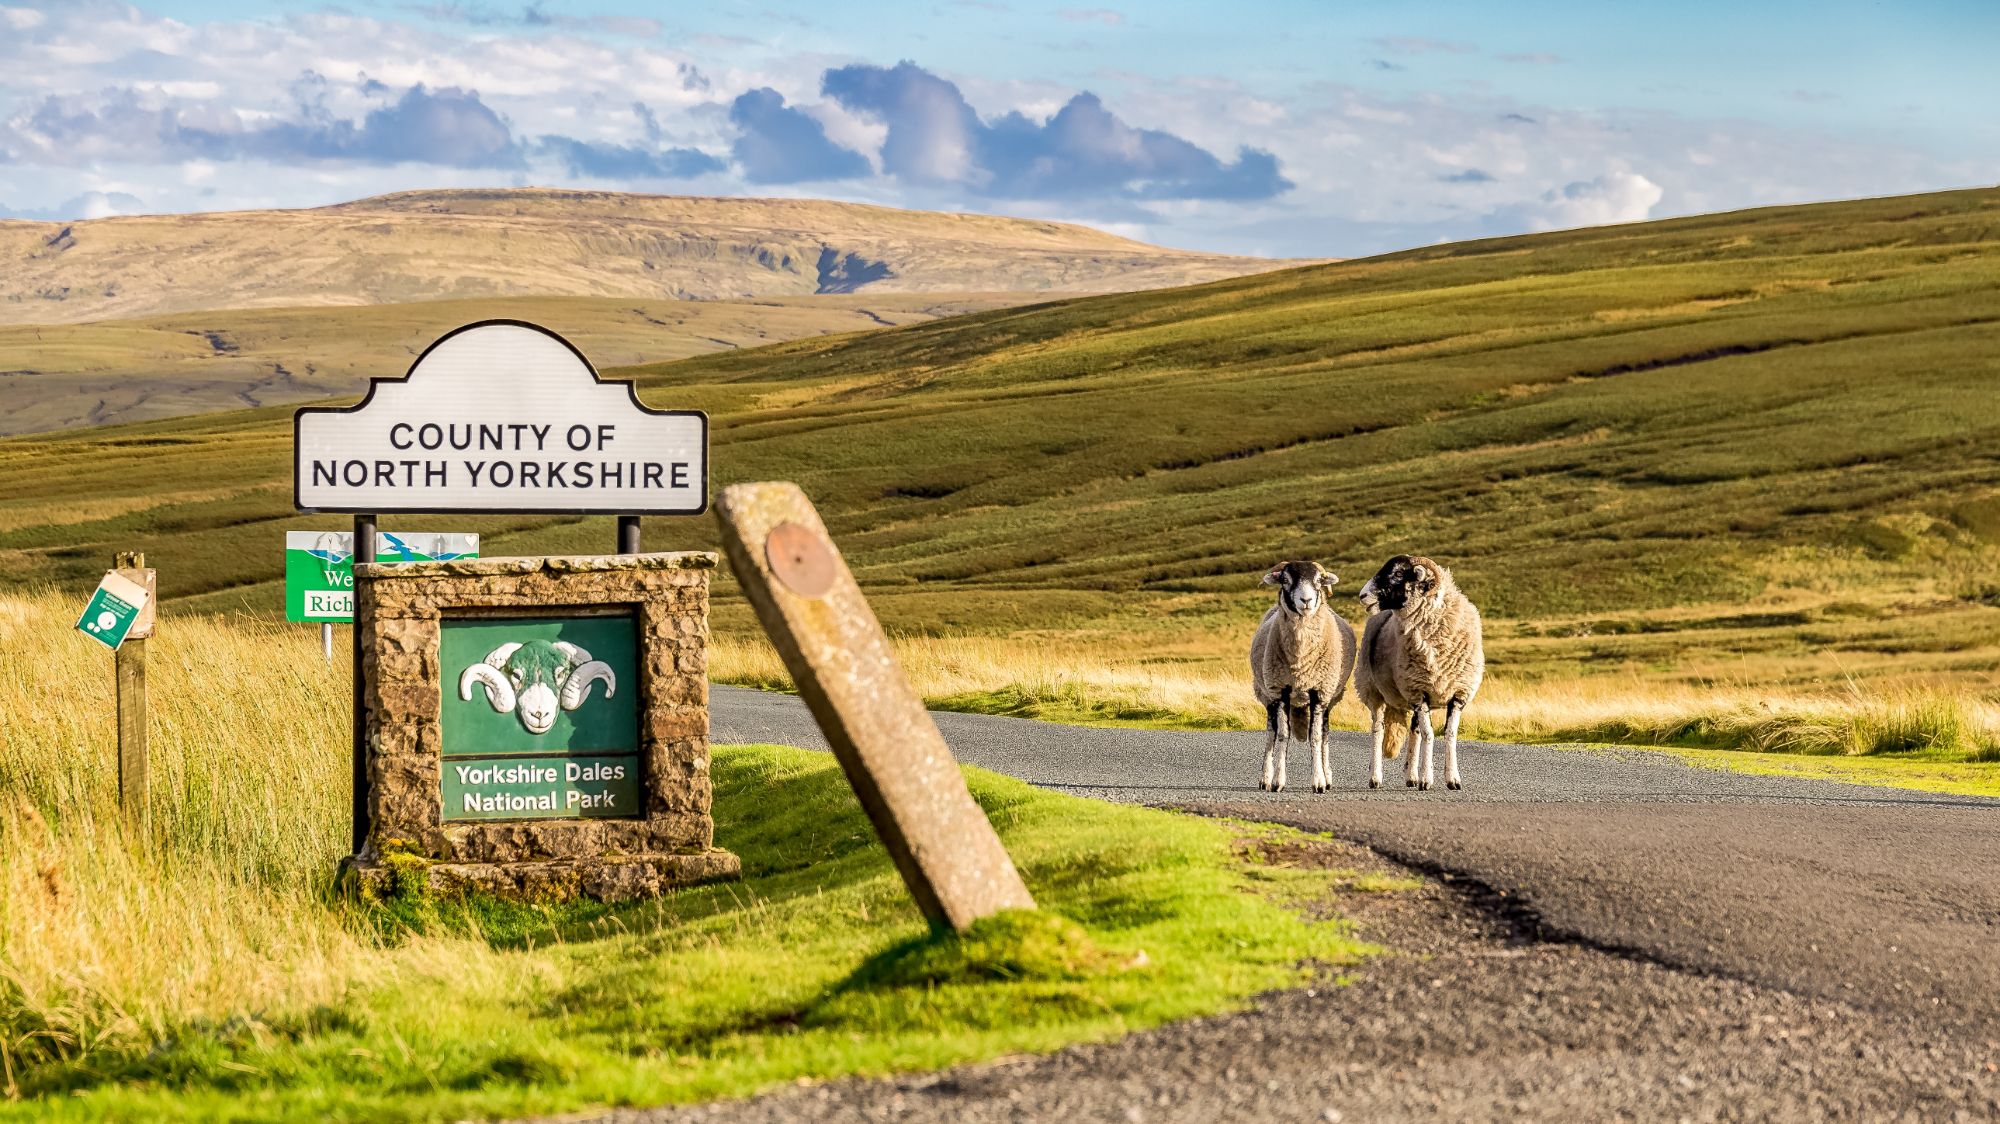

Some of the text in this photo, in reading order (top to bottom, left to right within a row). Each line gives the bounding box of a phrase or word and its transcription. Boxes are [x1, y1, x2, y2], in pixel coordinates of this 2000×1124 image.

[390, 423, 615, 450] COUNTY OF
[312, 460, 690, 488] NORTH YORKSHIRE
[456, 762, 625, 784] Yorkshire Dales
[463, 789, 615, 812] National Park
